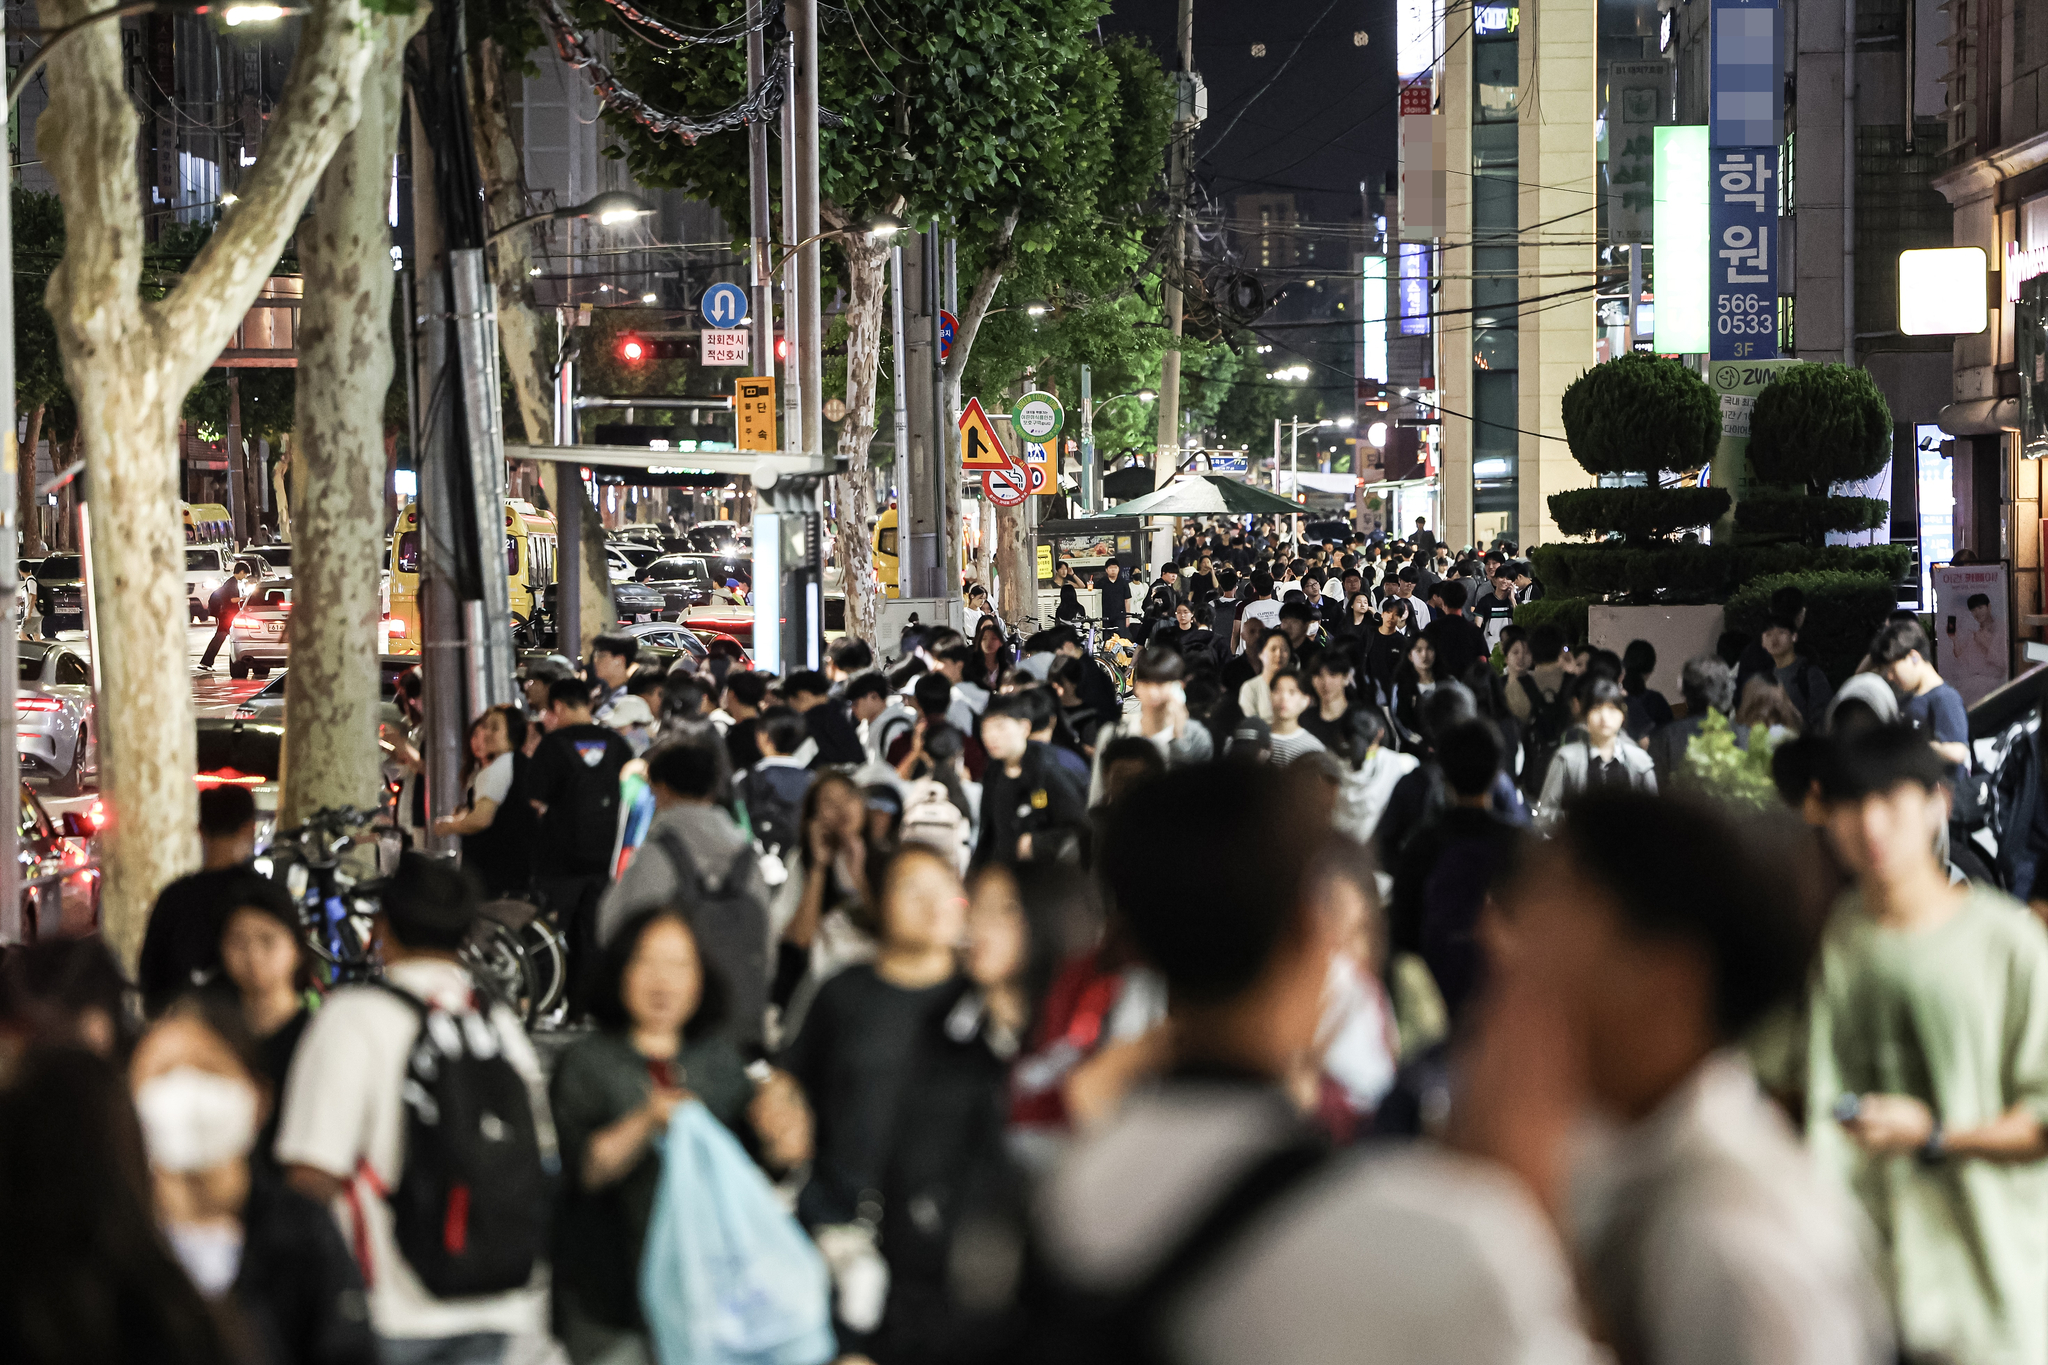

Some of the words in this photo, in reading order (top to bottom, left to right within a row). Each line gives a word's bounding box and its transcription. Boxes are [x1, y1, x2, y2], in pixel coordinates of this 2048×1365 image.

[1404, 105, 1427, 114] daiso
[1718, 154, 1772, 284] 학원
[1717, 293, 1770, 314] 566-
[1717, 314, 1773, 335] 0533
[707, 334, 744, 346] 좌회전시
[707, 350, 744, 361] 적신호시
[1733, 342, 1754, 357] 3F
[1724, 396, 1740, 405] 국내
[757, 402, 768, 440] 단속
